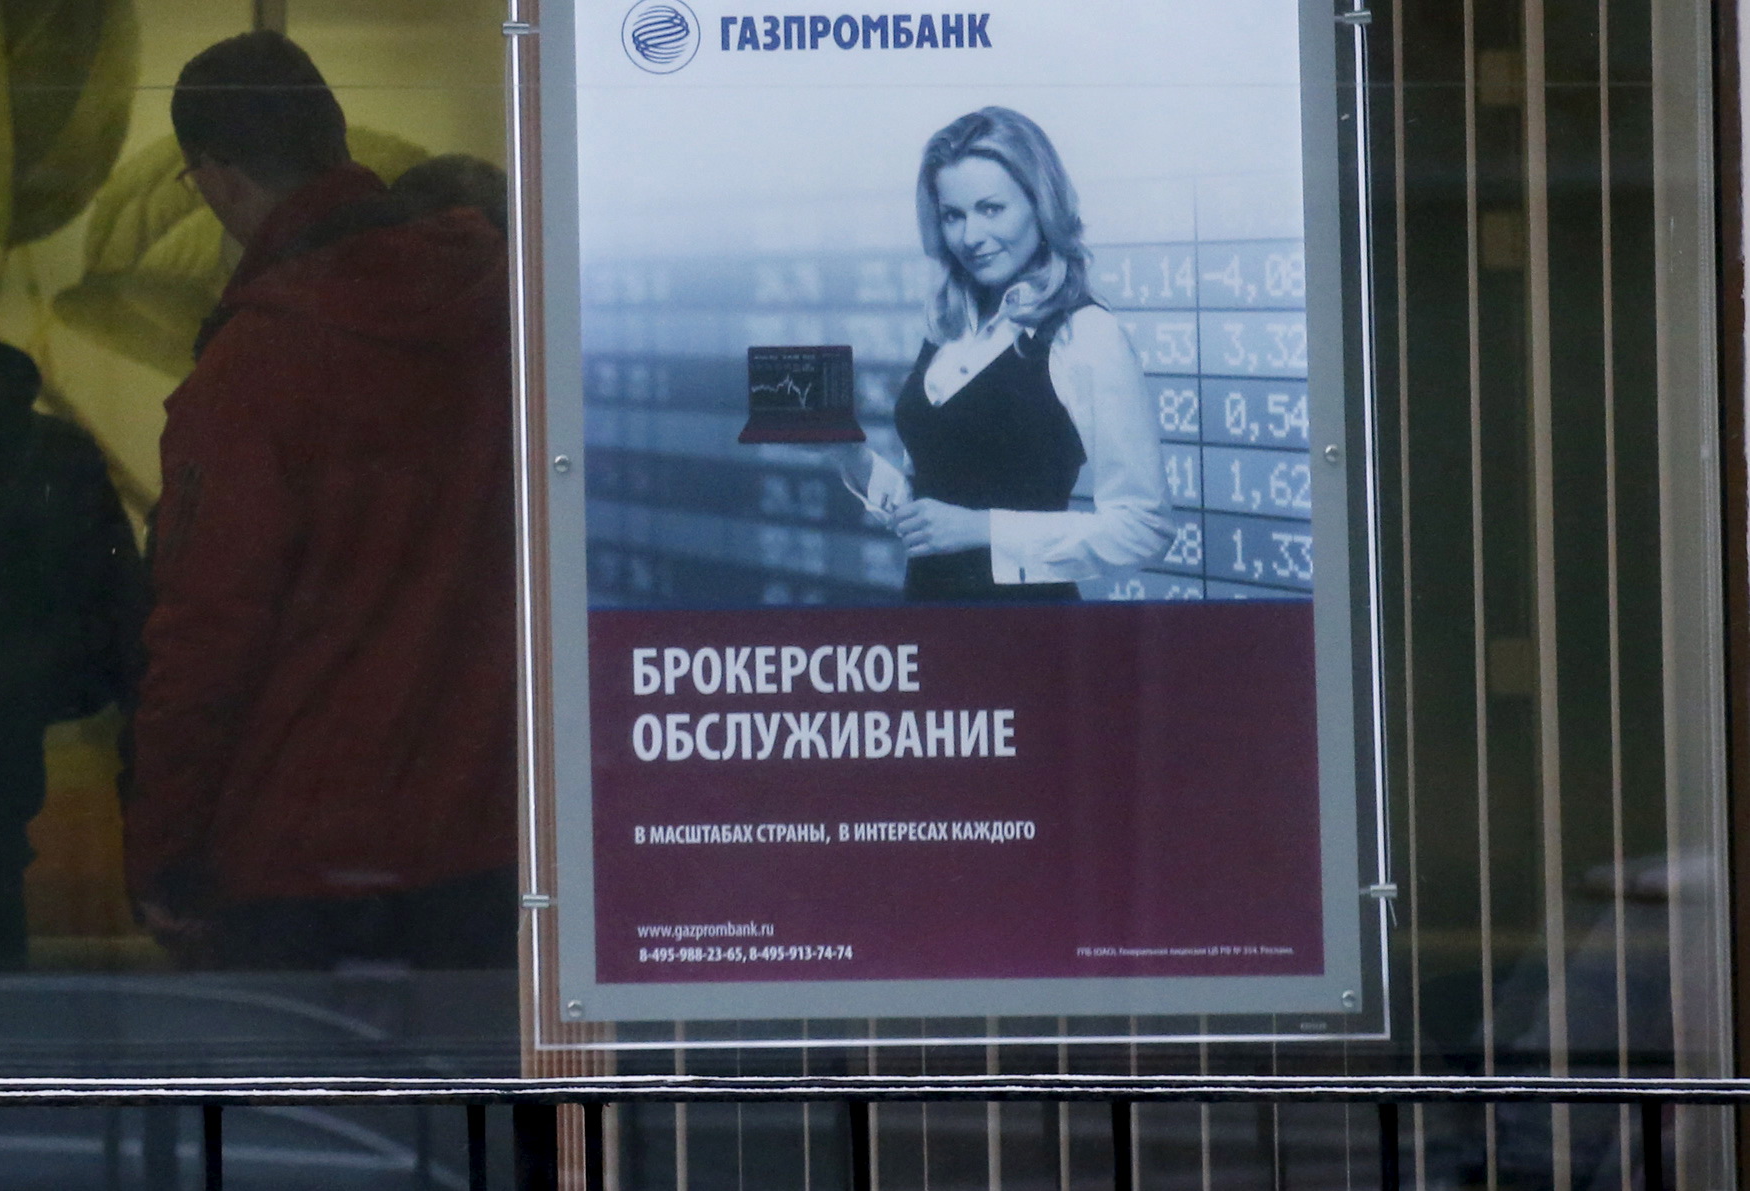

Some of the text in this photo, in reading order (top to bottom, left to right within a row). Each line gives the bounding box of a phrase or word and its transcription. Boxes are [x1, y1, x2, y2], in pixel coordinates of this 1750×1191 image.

[720, 13, 993, 51] ГАЗПРОМБАНК
[1225, 392, 1310, 442] 0,54
[1230, 459, 1312, 509] 1,62
[1232, 528, 1314, 580] 1,33
[632, 645, 920, 696] БРОКЕРСКОЕ
[632, 709, 1017, 762] ОБСЛУЖИВАНИЕ
[634, 821, 1036, 845] В МАСШТАБАХ СТРАНЫ, В ИНТЕРЕСАХ КАЖДОГО
[637, 920, 775, 942] www.gazprombank.ru
[639, 944, 854, 963] 8-495-988-23-65, 8-495-913-74-74
